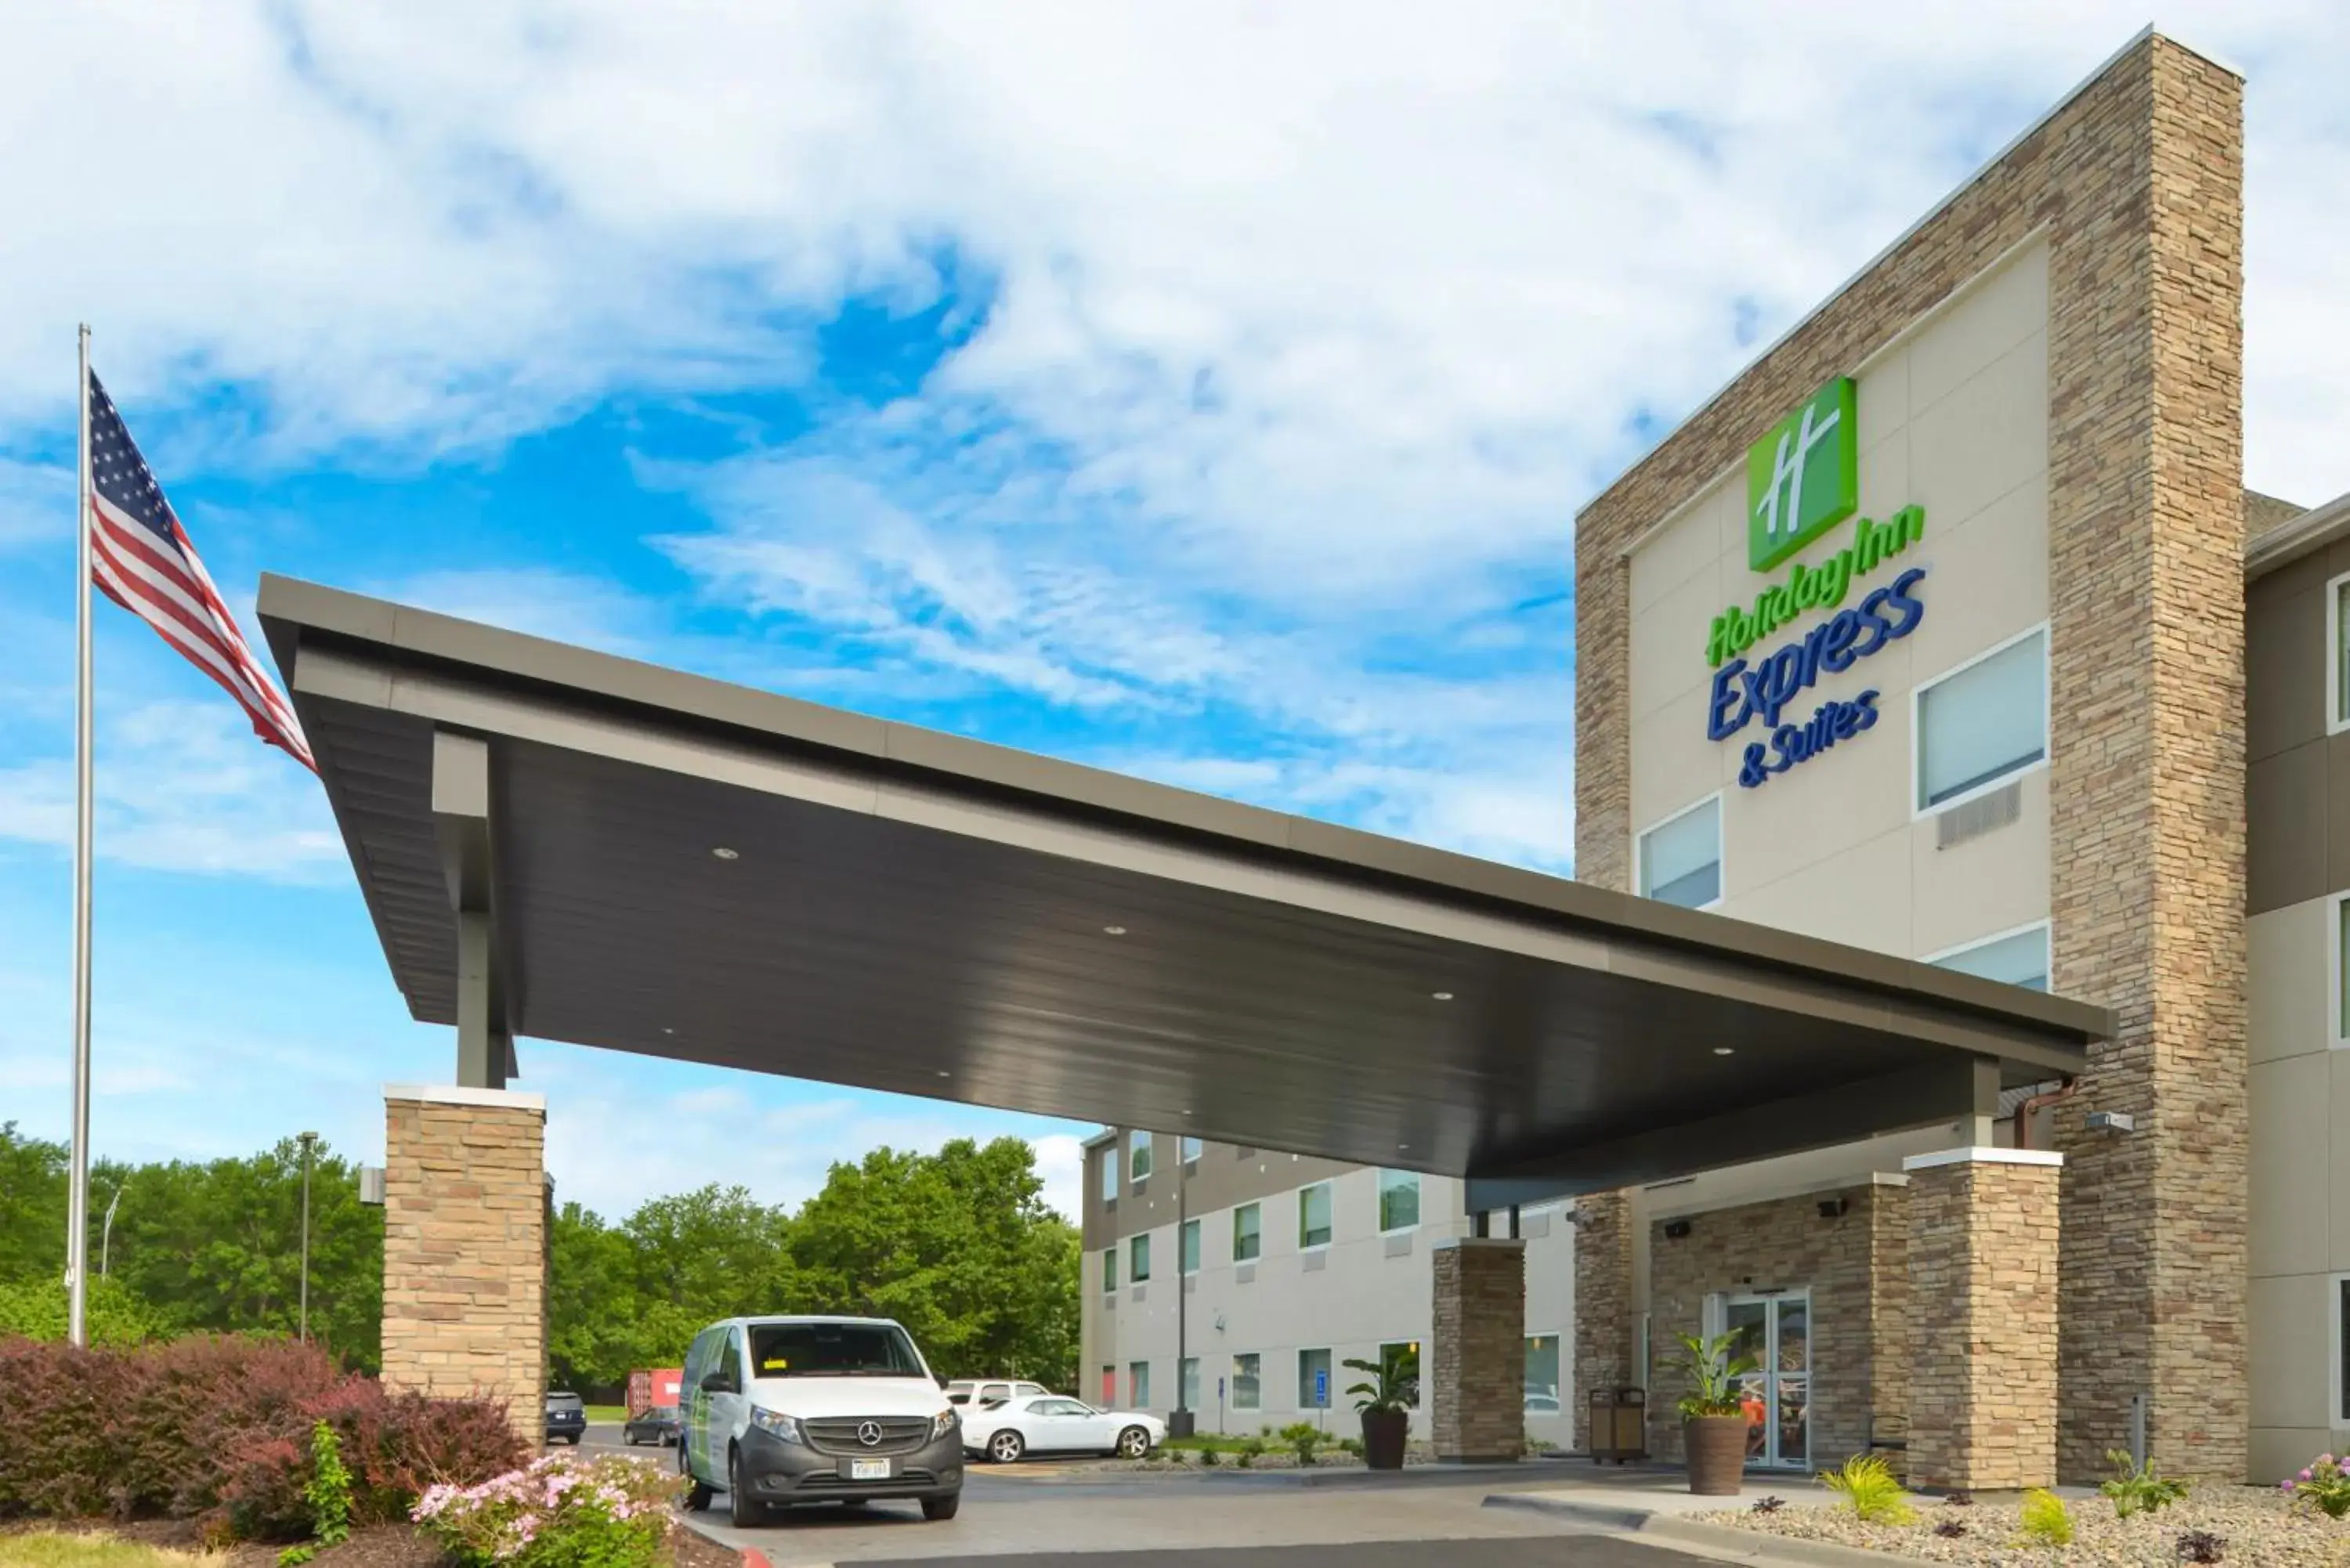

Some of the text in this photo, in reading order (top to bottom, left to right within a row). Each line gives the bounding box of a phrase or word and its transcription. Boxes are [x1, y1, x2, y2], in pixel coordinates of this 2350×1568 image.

[1755, 403, 1840, 536] H
[1705, 504, 1925, 667] Holiday Inn
[1708, 568, 1926, 741] Express
[1738, 689, 1880, 788] & Suites
